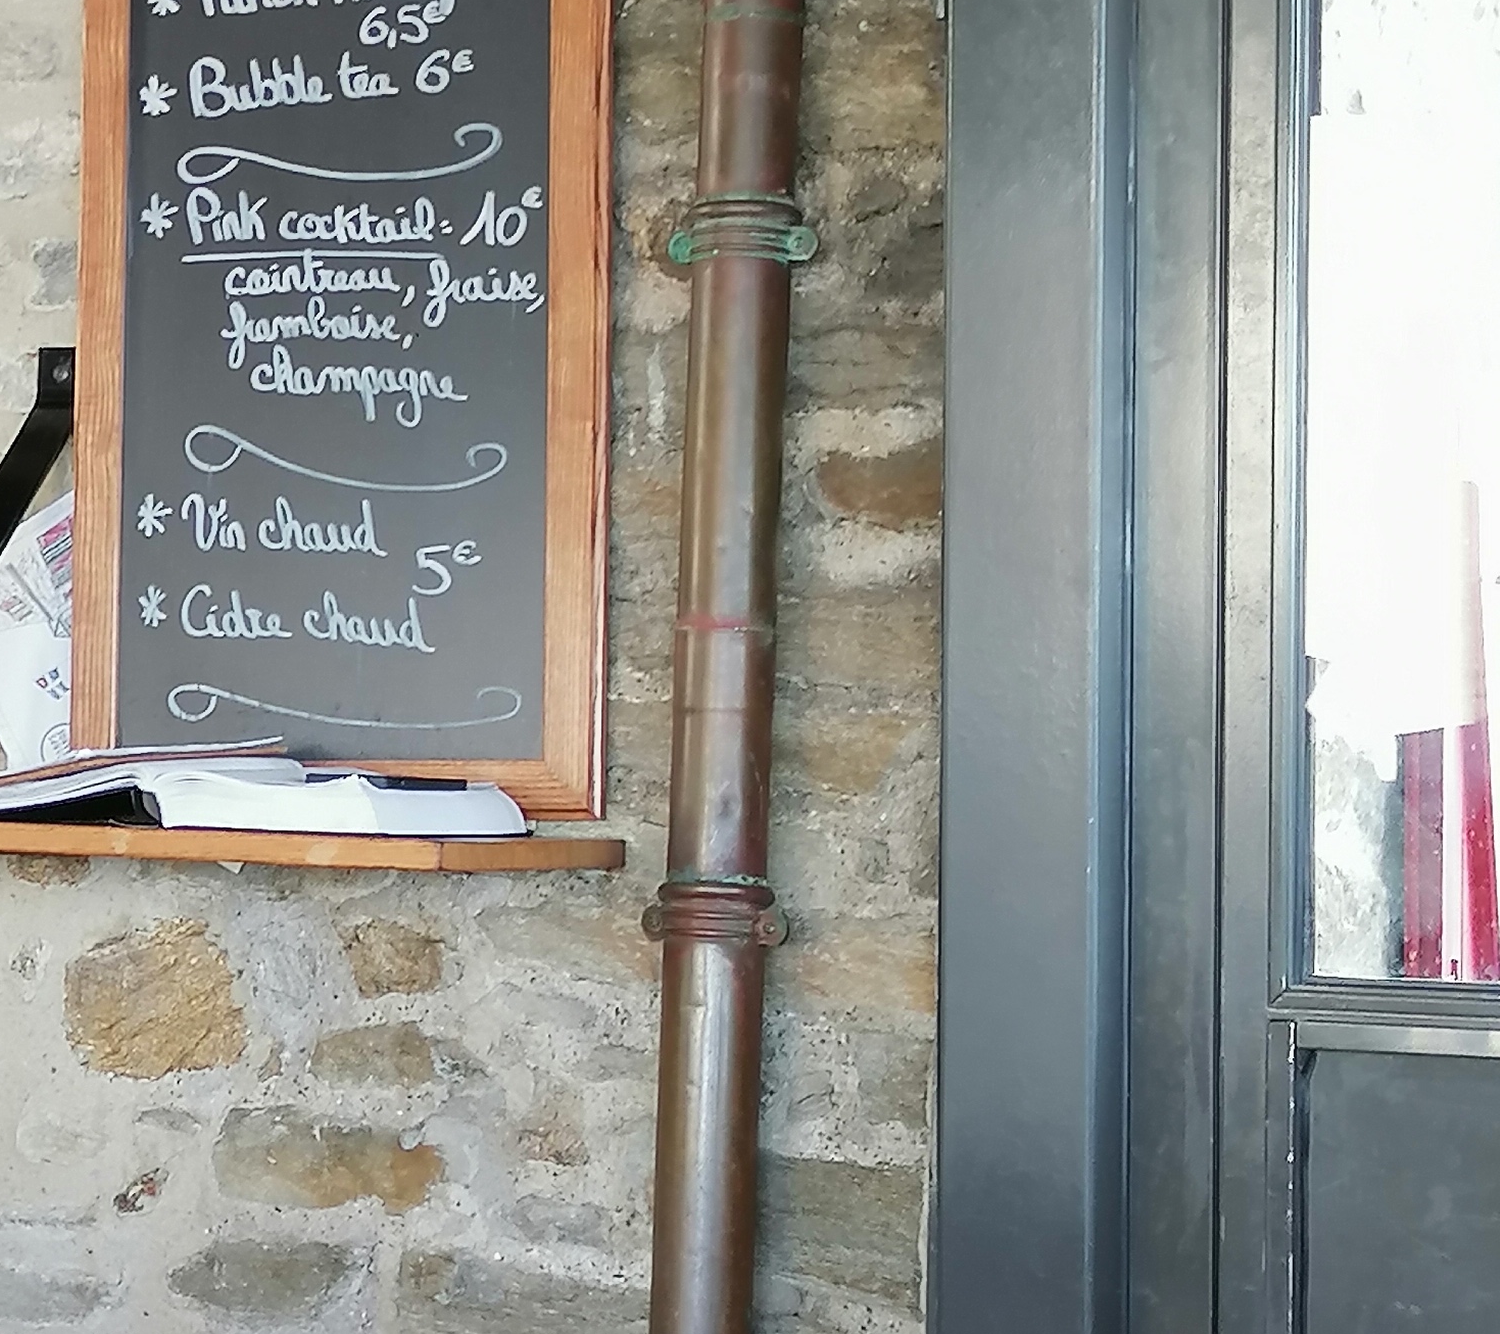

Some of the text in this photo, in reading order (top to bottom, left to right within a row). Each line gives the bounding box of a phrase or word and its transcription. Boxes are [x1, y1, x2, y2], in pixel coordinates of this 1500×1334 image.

[190, 57, 333, 118] Bubble
[338, 51, 400, 99] tea
[186, 186, 268, 245] Pink
[250, 344, 468, 427] champagne
[182, 493, 246, 551] Vin
[257, 499, 388, 557] chaud
[181, 584, 436, 654] Cidre chaud
